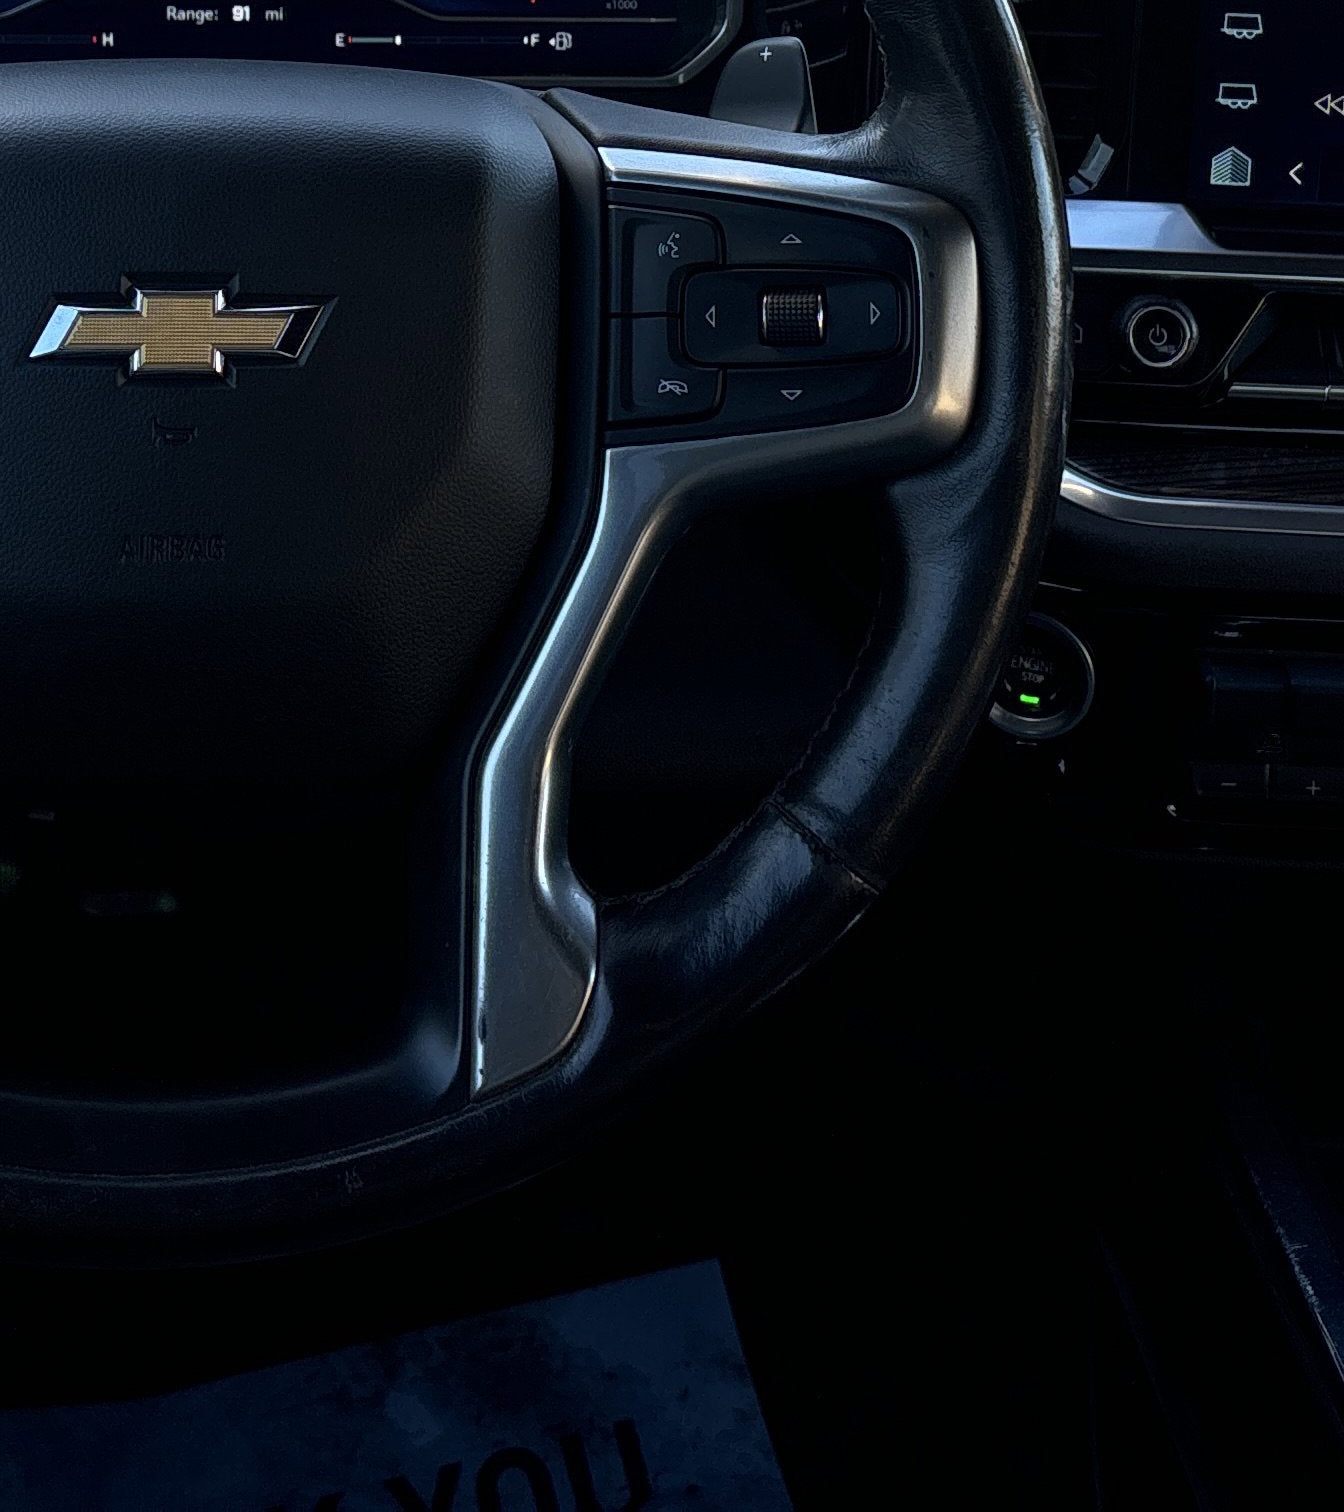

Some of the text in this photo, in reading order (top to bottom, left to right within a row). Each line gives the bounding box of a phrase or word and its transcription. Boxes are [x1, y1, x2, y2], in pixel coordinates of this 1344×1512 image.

[166, 5, 284, 25] Range: 91 mi
[102, 32, 114, 47] H
[335, 32, 345, 47] E
[530, 33, 540, 47] F
[121, 535, 226, 563] AIRBAG
